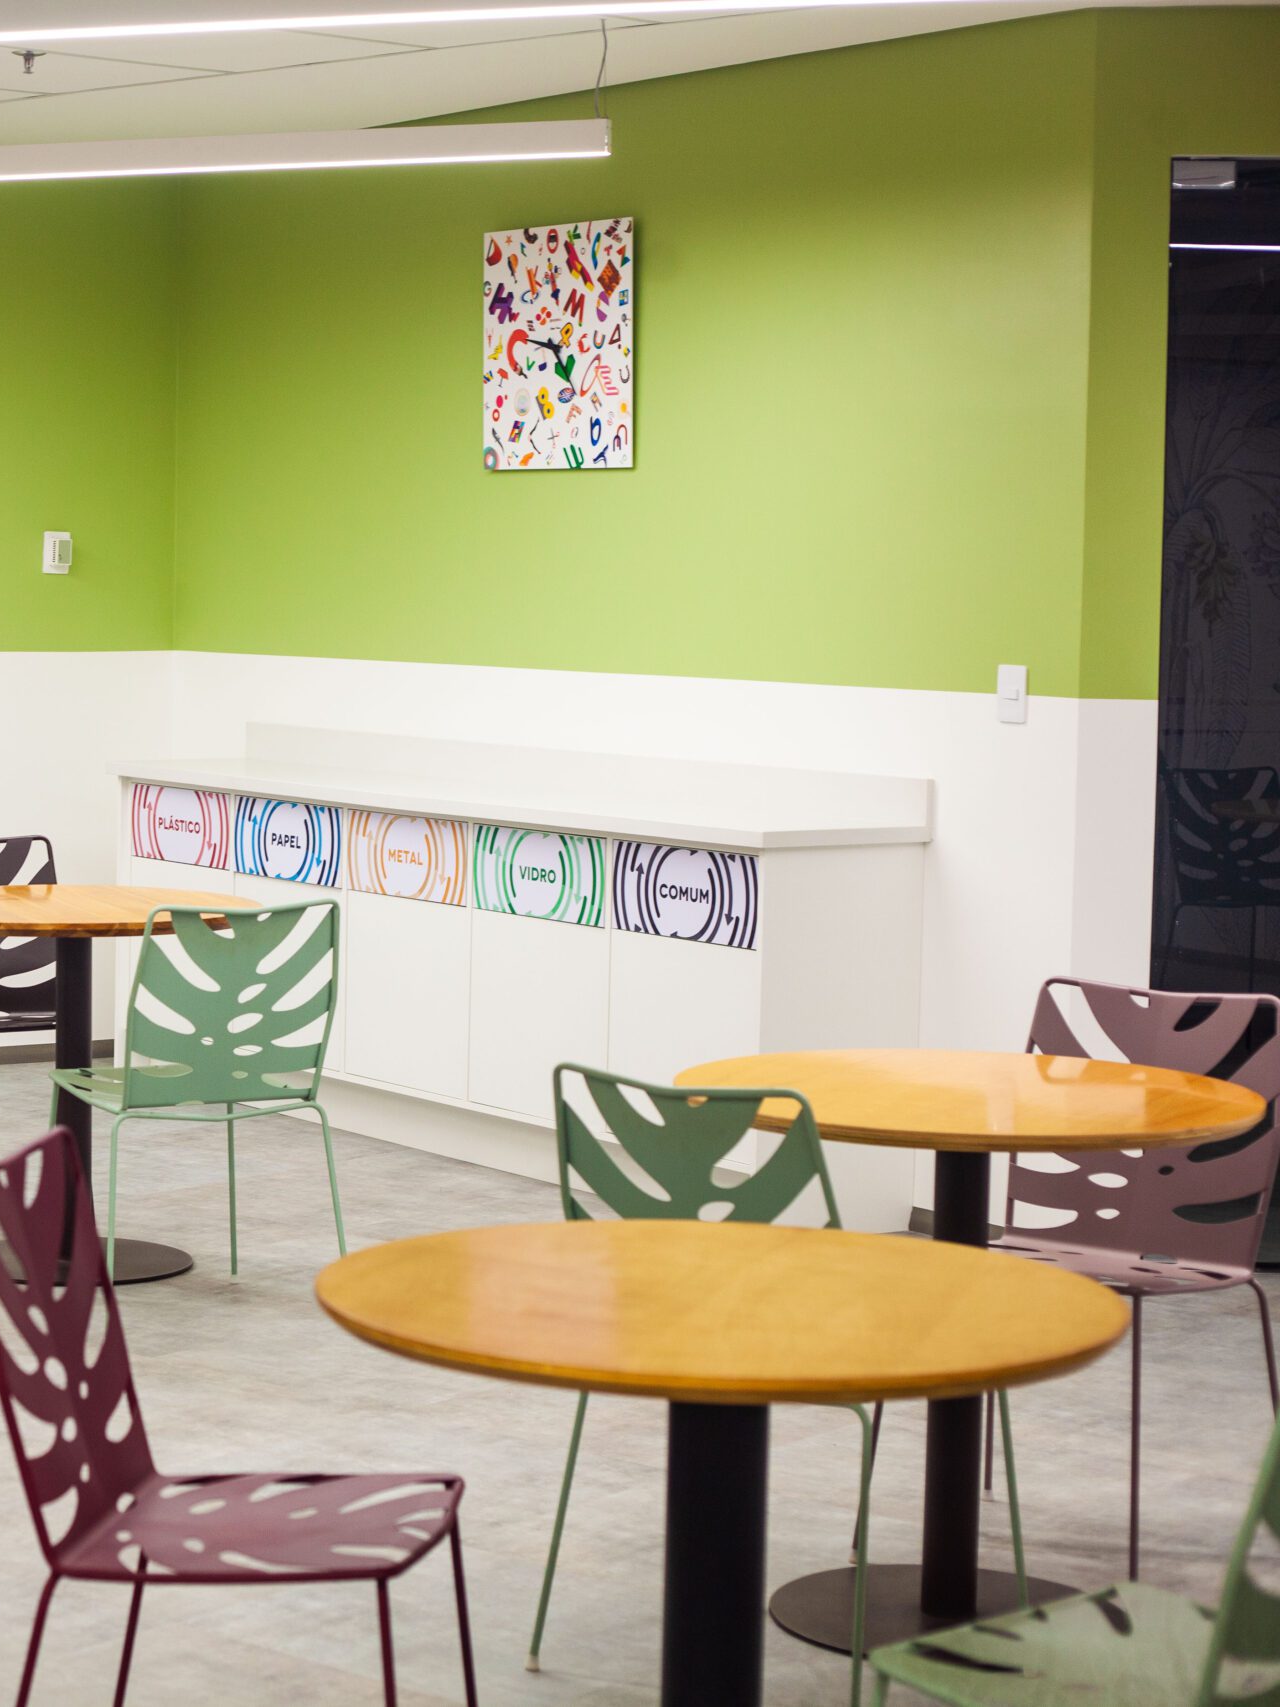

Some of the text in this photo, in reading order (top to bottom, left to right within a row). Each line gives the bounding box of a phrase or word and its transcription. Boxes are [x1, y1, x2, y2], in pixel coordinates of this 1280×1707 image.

[158, 815, 200, 834] PLÁSTICO
[271, 832, 301, 849] PAPEL
[388, 848, 423, 865] METAL
[519, 865, 556, 884] VIDRO
[659, 883, 709, 904] COMUM
